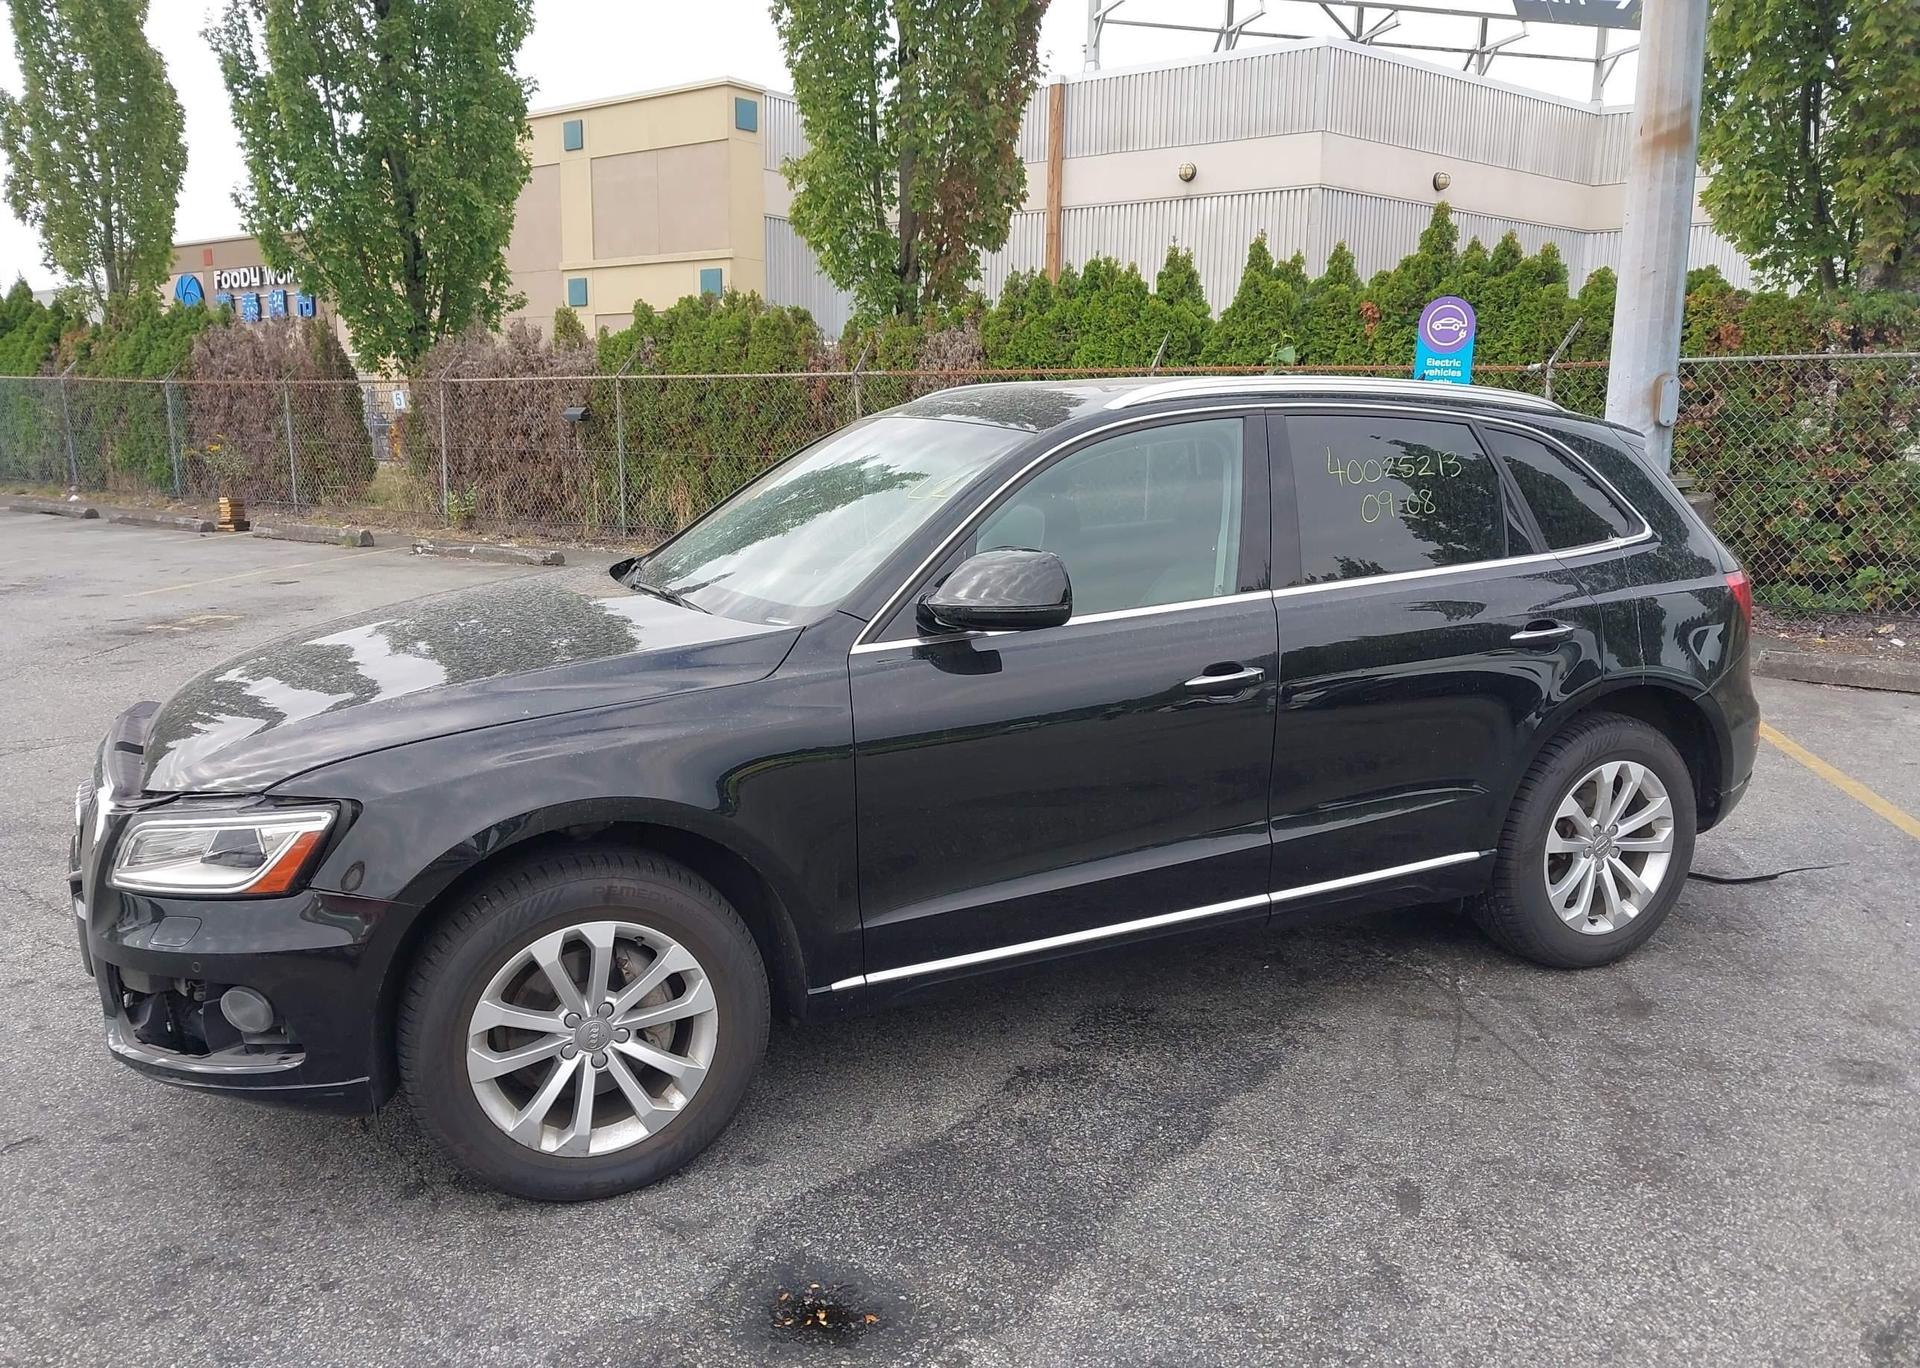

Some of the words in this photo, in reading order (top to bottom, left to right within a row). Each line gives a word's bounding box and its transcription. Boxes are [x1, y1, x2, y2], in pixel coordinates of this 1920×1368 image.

[1426, 357, 1462, 367] Electric
[1423, 367, 1462, 377] vehicles
[395, 392, 402, 406] 5
[1325, 446, 1463, 488] 40025213
